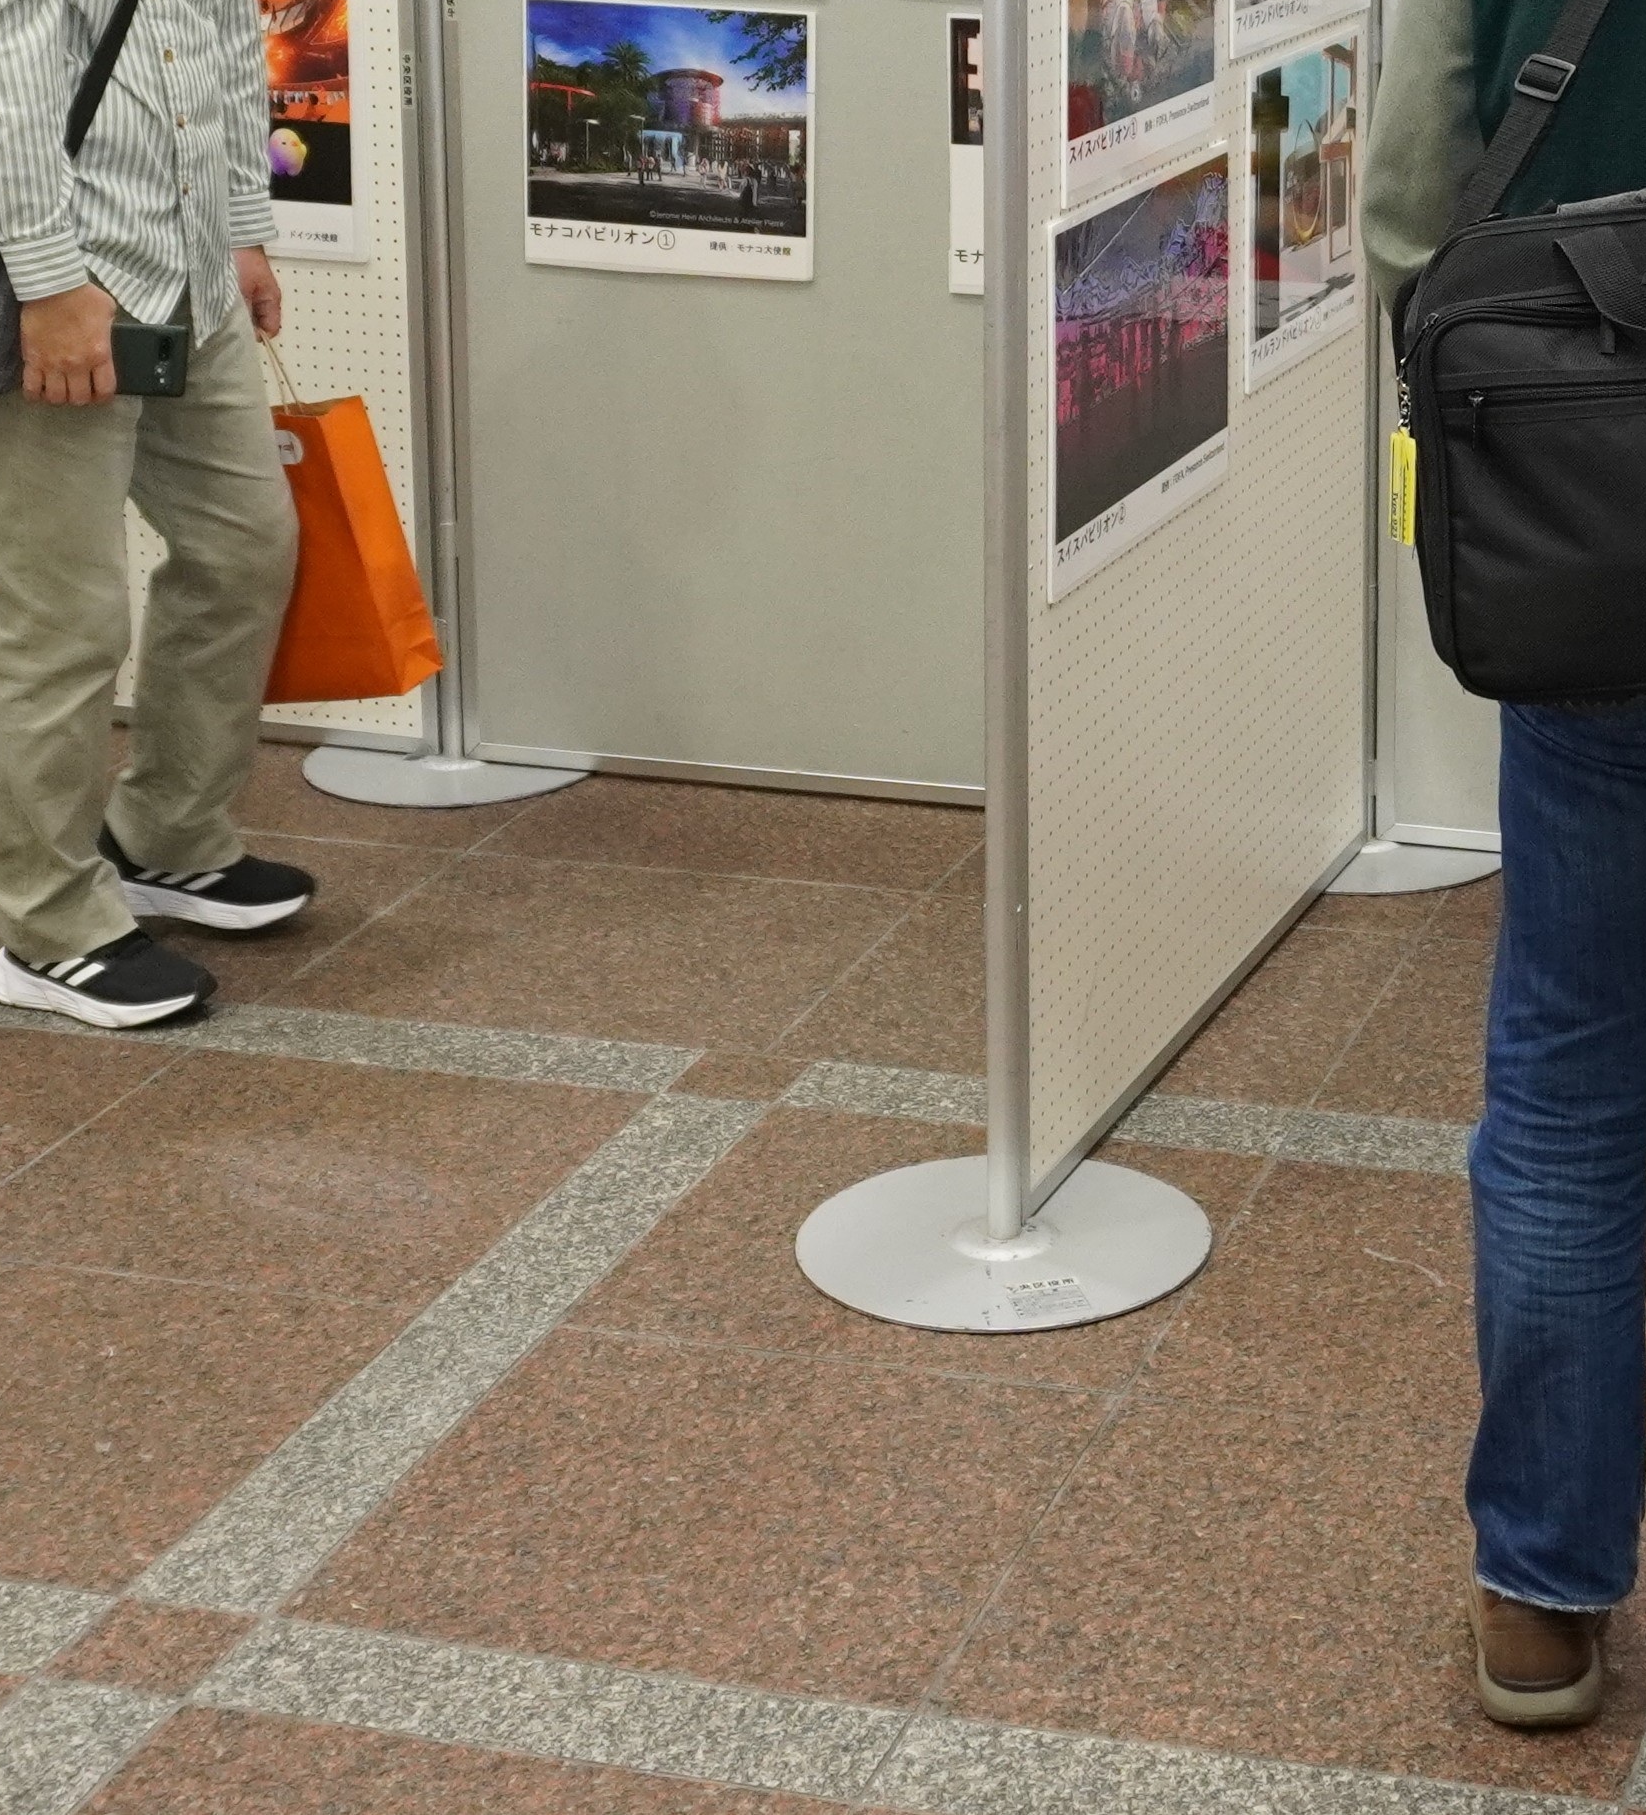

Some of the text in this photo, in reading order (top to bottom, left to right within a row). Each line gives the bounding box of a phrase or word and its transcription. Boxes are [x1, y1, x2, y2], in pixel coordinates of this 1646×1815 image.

[529, 222, 676, 251] モナコパビリオン①
